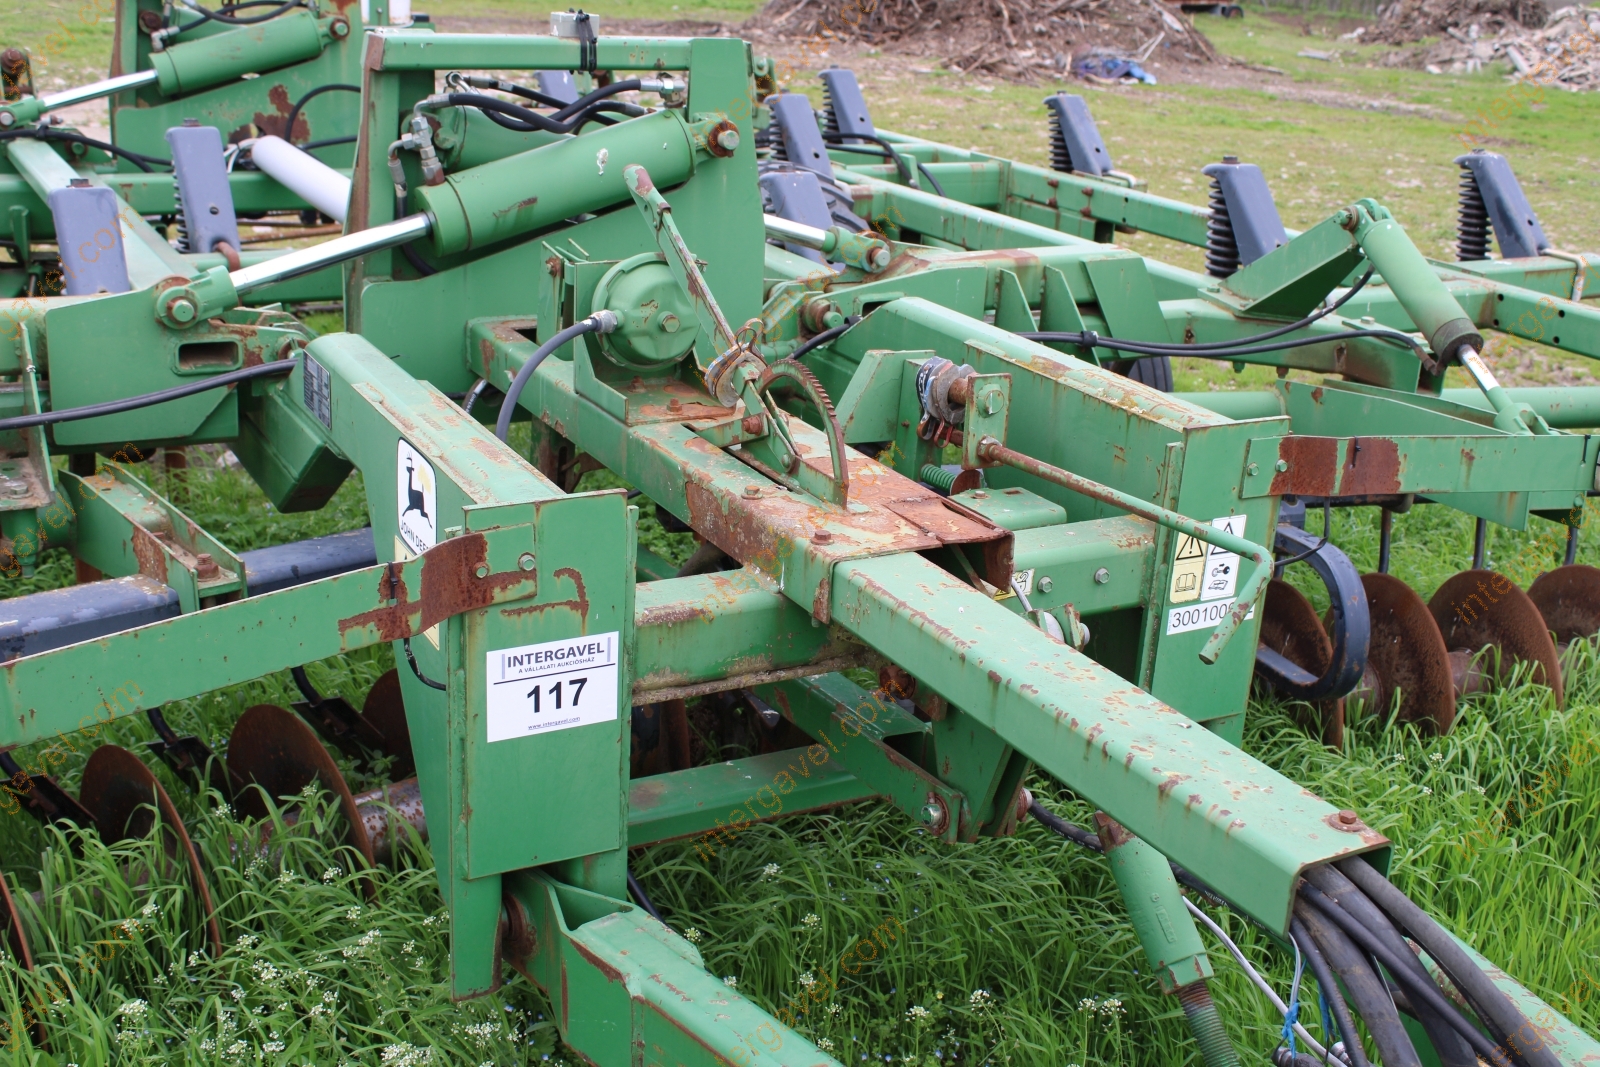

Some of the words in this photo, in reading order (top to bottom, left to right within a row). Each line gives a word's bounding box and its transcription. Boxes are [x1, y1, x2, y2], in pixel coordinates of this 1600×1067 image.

[401, 519, 415, 543] JOHN
[415, 534, 429, 552] DEE
[507, 642, 605, 668] INTERGAVEL
[524, 663, 556, 673] VÁLLALATI
[556, 656, 595, 668] AUKCIÓSHÁZ
[527, 677, 588, 713] 117
